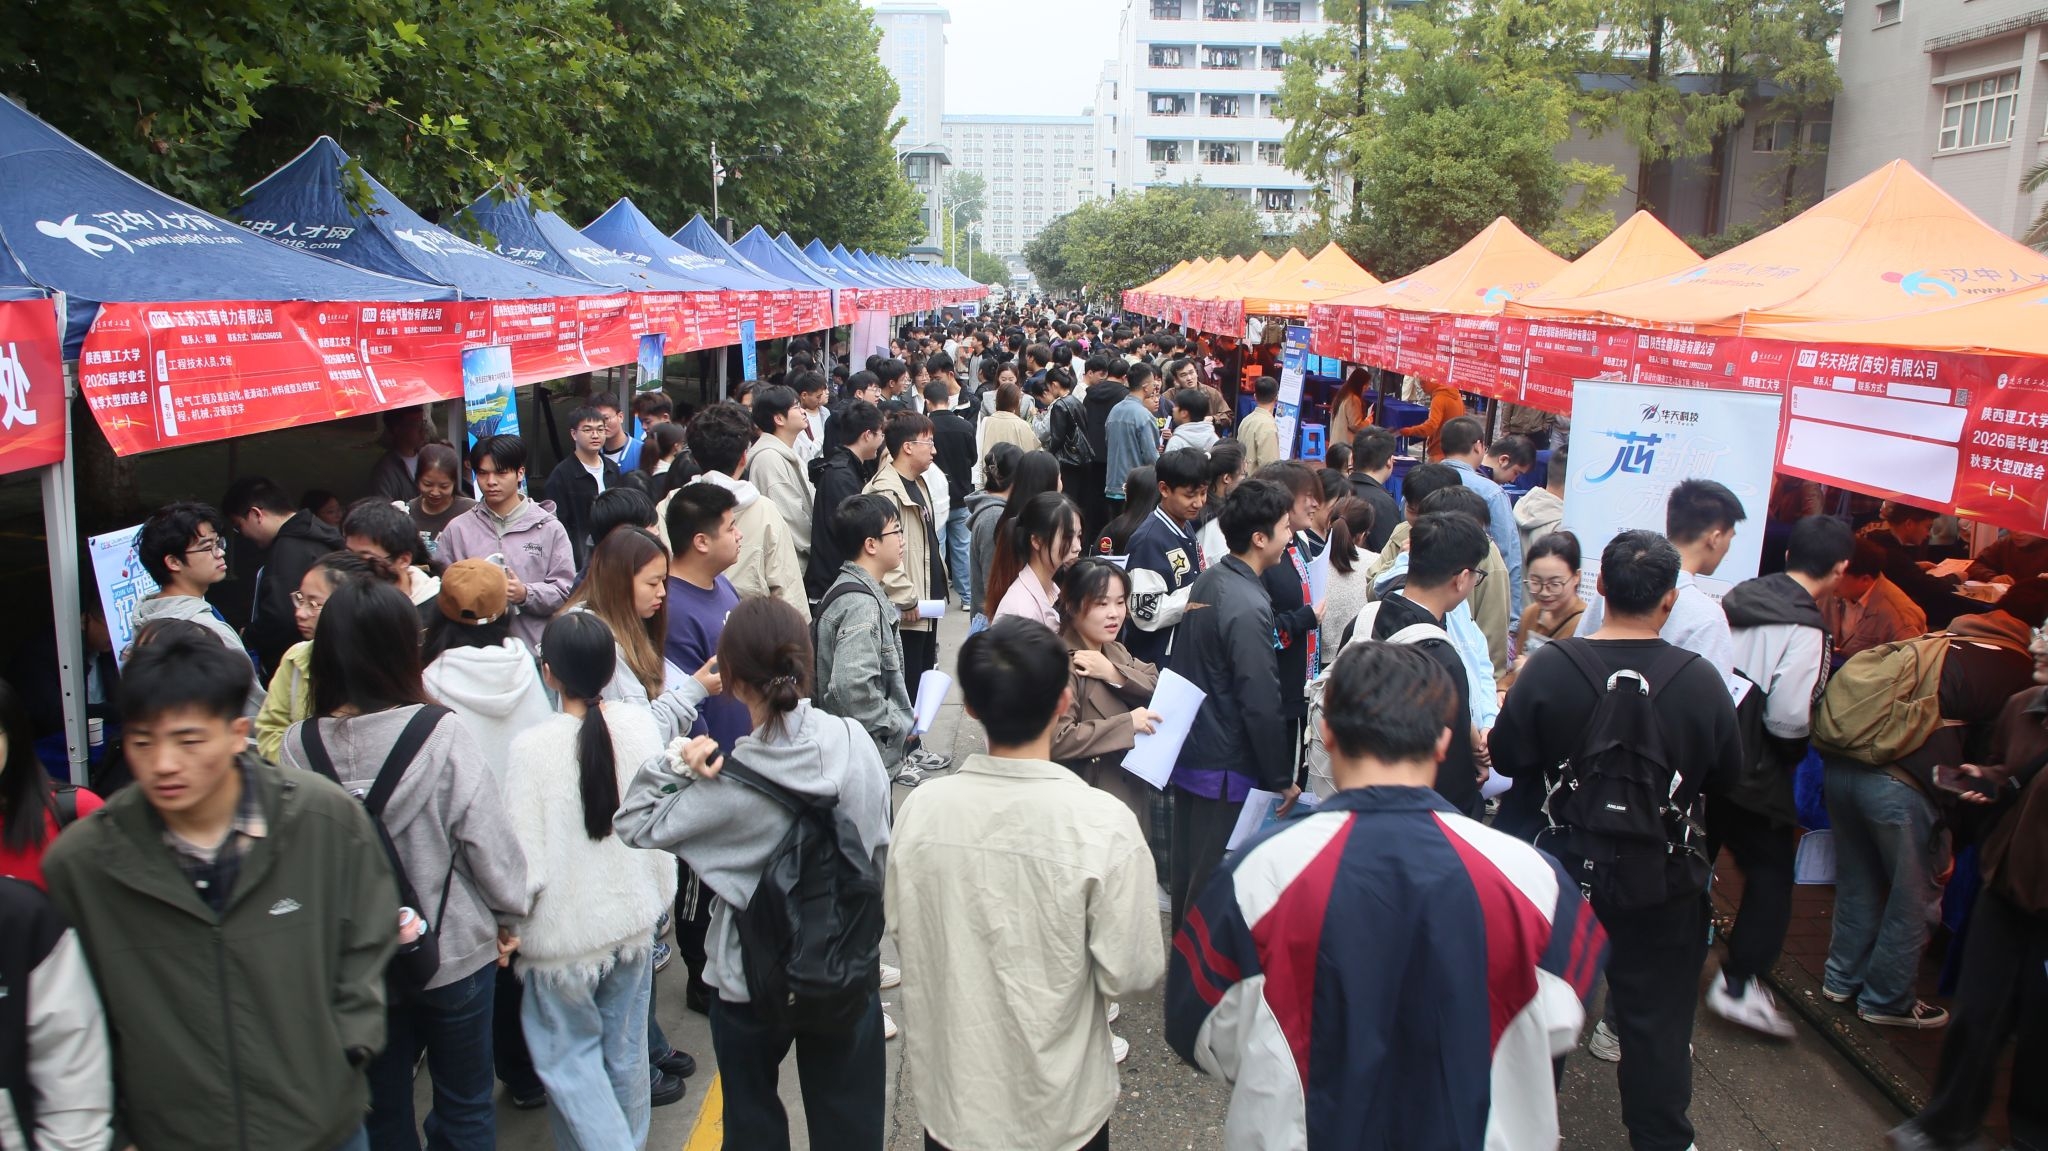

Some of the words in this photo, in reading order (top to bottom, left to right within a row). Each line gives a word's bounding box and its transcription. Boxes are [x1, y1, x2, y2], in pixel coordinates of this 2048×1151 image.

[92, 209, 222, 234] 汉中人才网
[173, 309, 273, 327] 江苏江南电力有限公司
[363, 309, 376, 321] 002
[380, 308, 442, 322] 合容电气股份有限公司
[318, 337, 351, 348] 陕西理工大学
[1650, 336, 1716, 357] 陕西金鼎铸造有限公司
[85, 348, 141, 365] 陕西理工大学
[1799, 351, 1816, 366] 077
[1818, 352, 1938, 380] 华天科技(西安)有限公司
[84, 369, 147, 388] 2026届毕业生
[1742, 376, 1780, 391] 陕西理工大学
[89, 391, 148, 411] 秋季大型双选会
[1661, 409, 1699, 423] 华天科技
[1981, 406, 2048, 429] 陕西理工大学
[1972, 430, 2048, 455] 2026届毕业生
[1970, 453, 2045, 481] 秋季大型双选会
